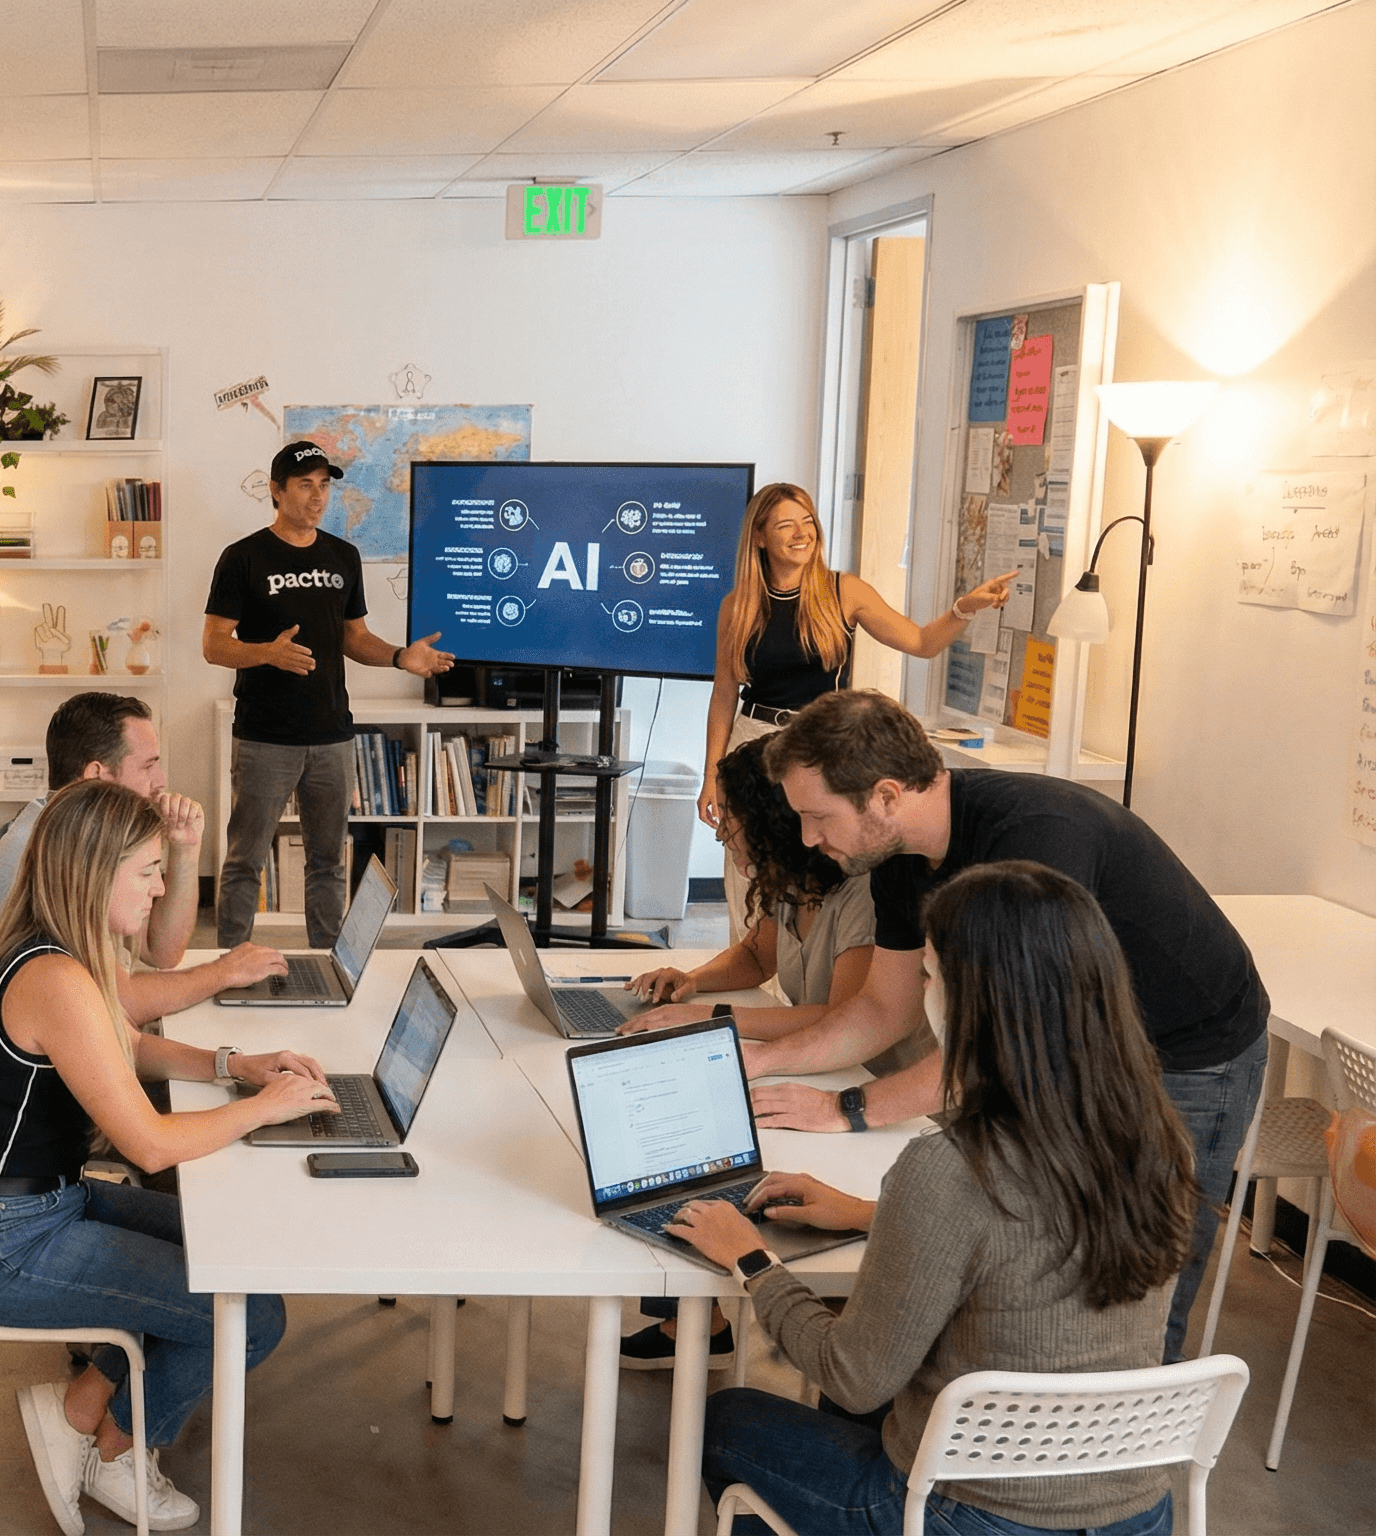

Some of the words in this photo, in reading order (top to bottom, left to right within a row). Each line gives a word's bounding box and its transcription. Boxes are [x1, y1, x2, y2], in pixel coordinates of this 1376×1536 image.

[523, 186, 591, 235] EXIT
[267, 568, 344, 595] pactto
[537, 541, 600, 591] AI
